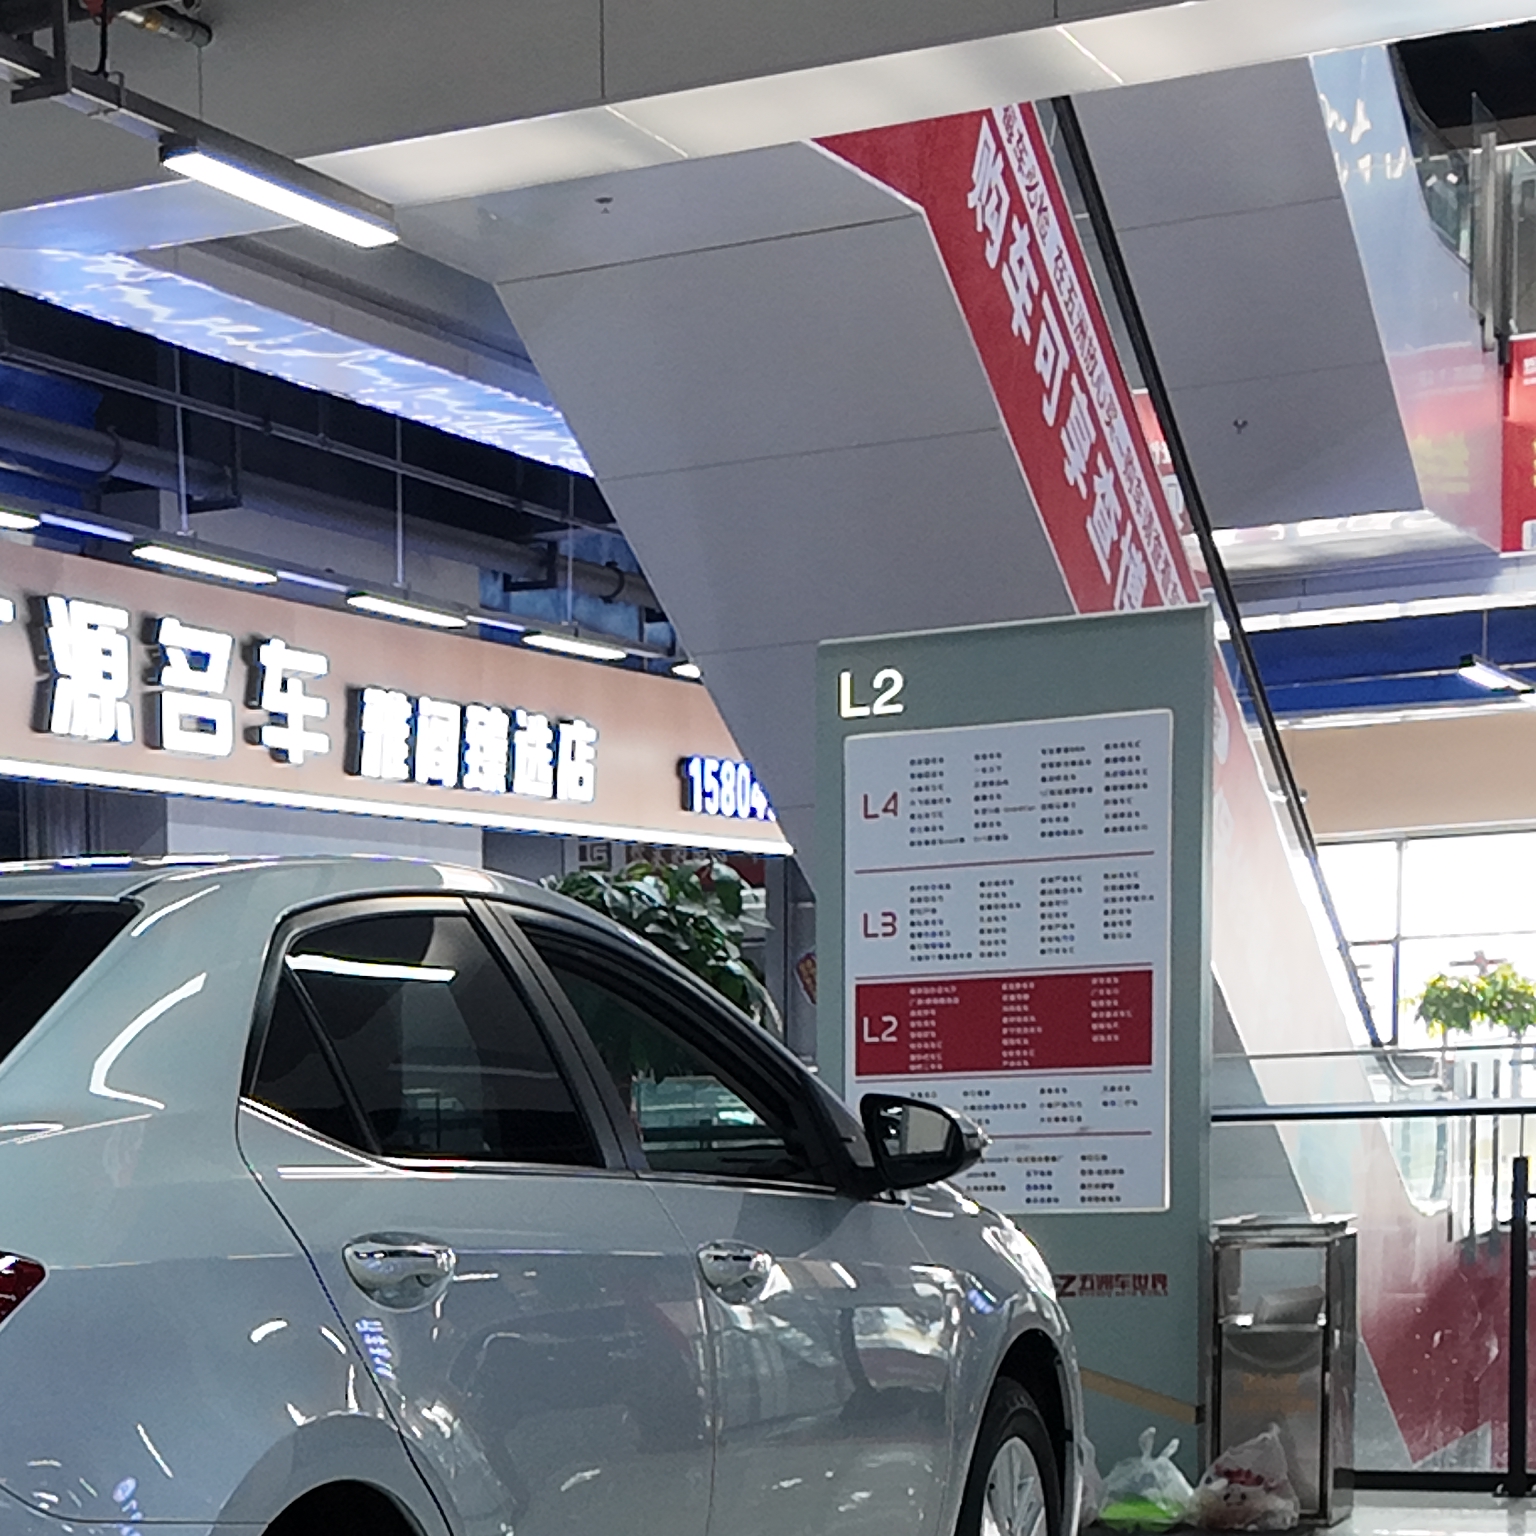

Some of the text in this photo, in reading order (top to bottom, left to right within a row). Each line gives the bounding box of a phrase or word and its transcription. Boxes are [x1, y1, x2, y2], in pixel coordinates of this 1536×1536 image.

[839, 669, 905, 718] L2
[863, 792, 899, 819] L4
[863, 912, 899, 939] L3
[863, 1016, 899, 1043] L2
